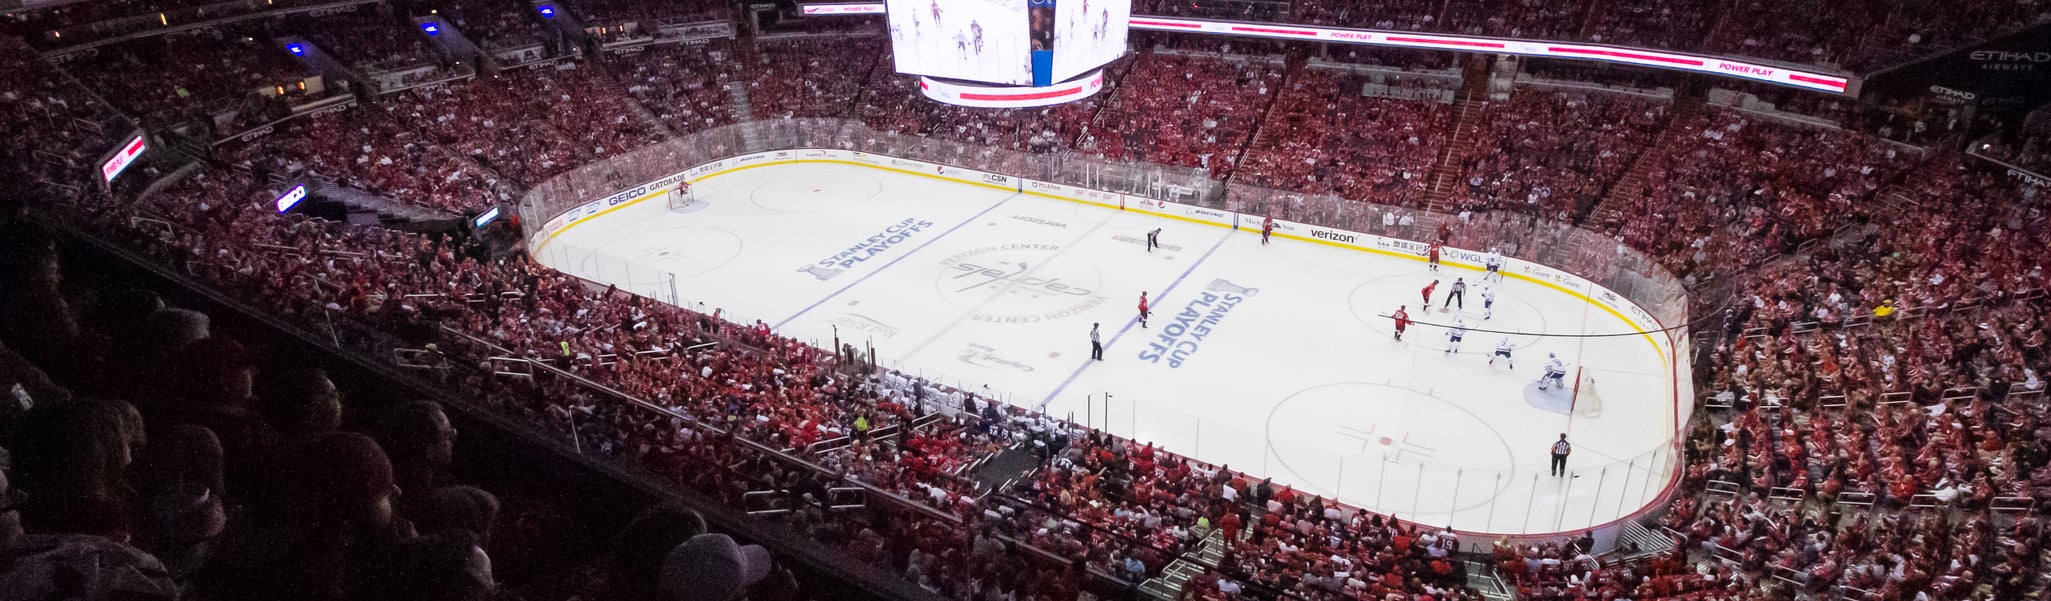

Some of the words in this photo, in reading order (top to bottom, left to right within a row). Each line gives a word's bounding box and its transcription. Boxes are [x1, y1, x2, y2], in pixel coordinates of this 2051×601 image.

[1970, 50, 2051, 62] ETIHAD
[1719, 62, 1750, 73] POWER
[1751, 67, 1774, 76] PLAY
[1930, 85, 1975, 100] ETIHAD
[310, 104, 347, 119] ETIHAD
[241, 126, 275, 142] ETIHAD
[649, 173, 687, 191] GATORADE
[991, 174, 1008, 183] CSN
[1037, 182, 1061, 191] McAfee
[608, 186, 646, 206] GEICO
[1194, 209, 1225, 219] BOEING
[819, 233, 886, 267] STANLEY
[885, 217, 915, 234] CUP
[838, 219, 934, 269] PLAYOFFS
[1310, 229, 1355, 244] verizon
[937, 245, 998, 267] VERIZON
[1000, 243, 1060, 251] CENTER
[1460, 252, 1484, 264] WGL
[1532, 268, 1551, 280] Giant
[1562, 277, 1581, 289] Giant
[1045, 296, 1110, 321] VERIZON
[971, 313, 1041, 324] CENTER
[1190, 292, 1243, 342] STANLEY
[1630, 305, 1662, 332] ETIHAD
[1138, 291, 1219, 364] PLAYOFFS
[1166, 340, 1198, 369] CUP
[1442, 538, 1453, 550] 19
